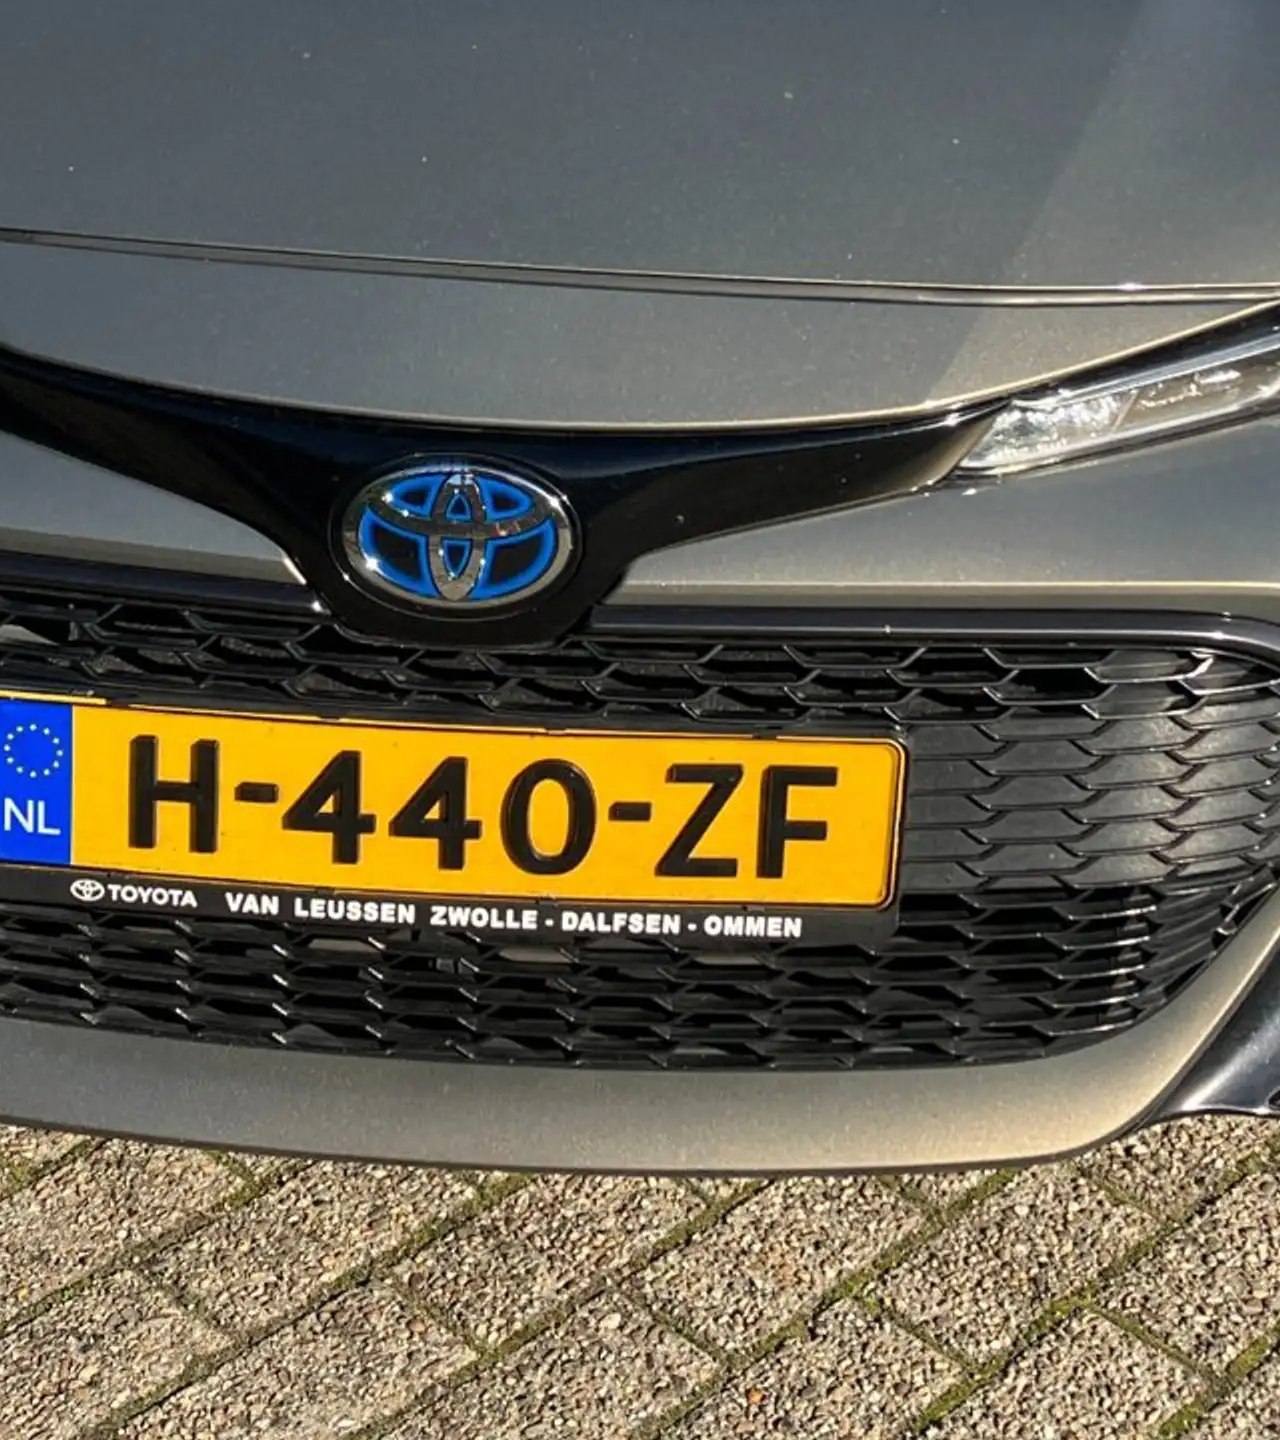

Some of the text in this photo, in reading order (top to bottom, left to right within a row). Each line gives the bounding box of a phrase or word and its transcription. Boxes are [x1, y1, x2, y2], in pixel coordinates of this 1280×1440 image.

[3, 797, 62, 836] NL
[127, 734, 840, 880] H-440-ZF
[107, 883, 198, 908] TOYOTA
[225, 891, 279, 916] VAN
[294, 897, 416, 924] LEUSSEN
[430, 905, 538, 930] ZWOLLE
[561, 911, 681, 934] DALFSEN
[704, 915, 803, 938] OMMEN
